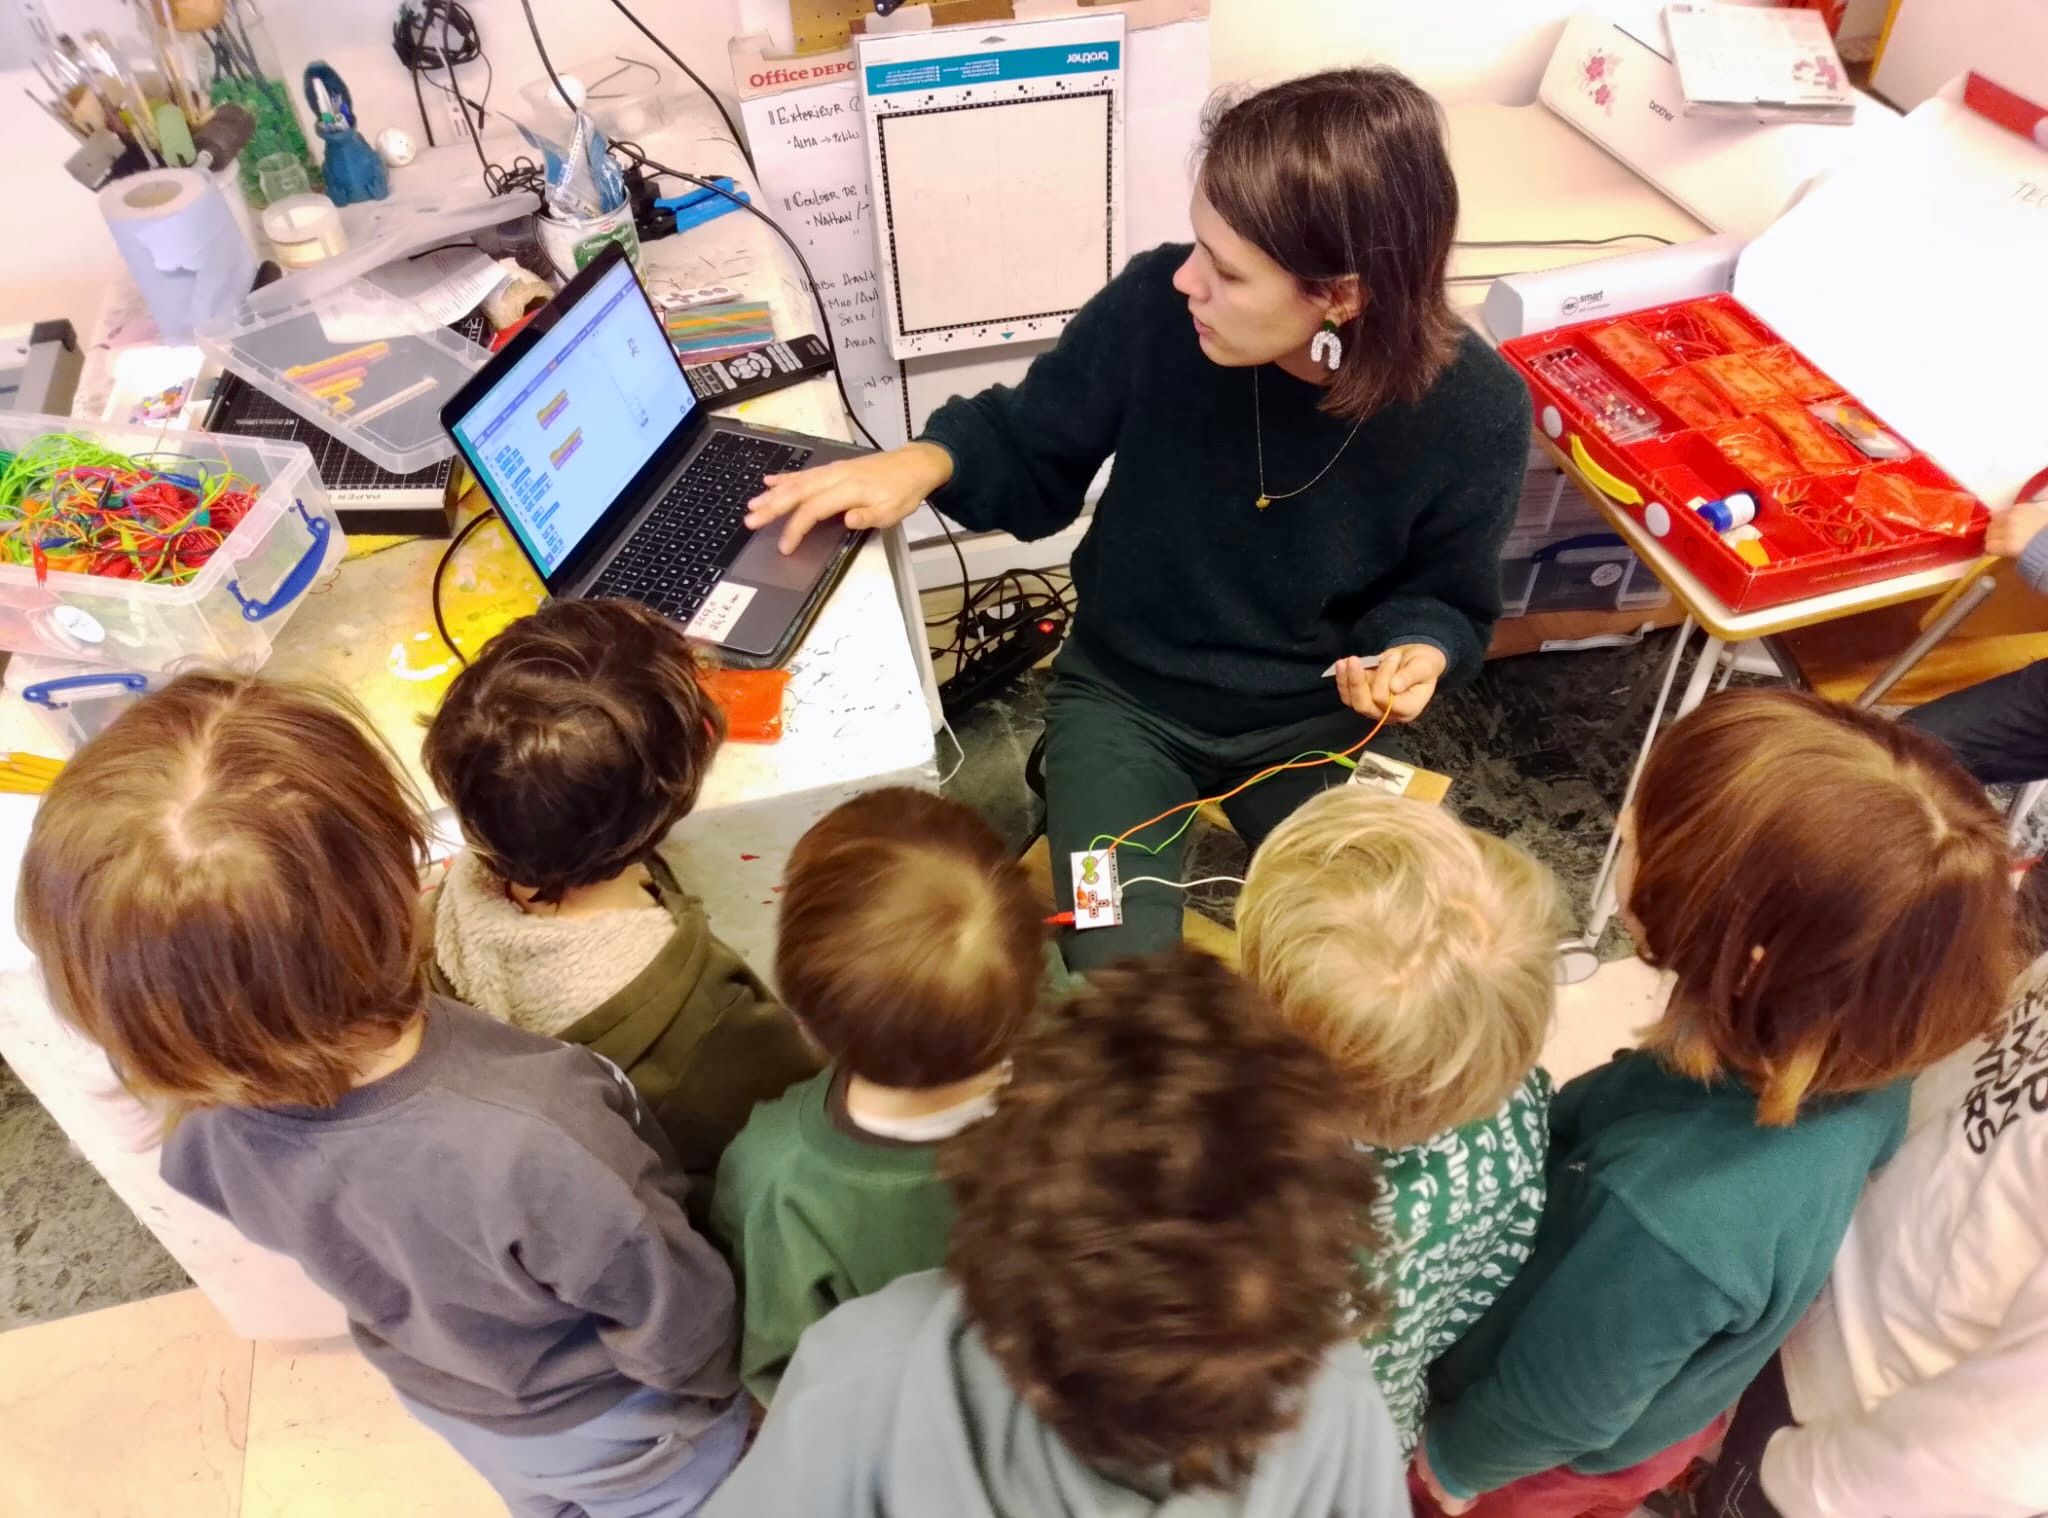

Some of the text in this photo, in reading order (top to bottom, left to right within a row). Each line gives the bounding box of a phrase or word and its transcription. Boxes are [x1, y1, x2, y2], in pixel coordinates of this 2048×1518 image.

[1066, 50, 1109, 65] brother
[750, 68, 808, 87] Office
[1649, 99, 1675, 122] brother
[1579, 290, 1603, 303] smart
[337, 493, 381, 501] PAPER
